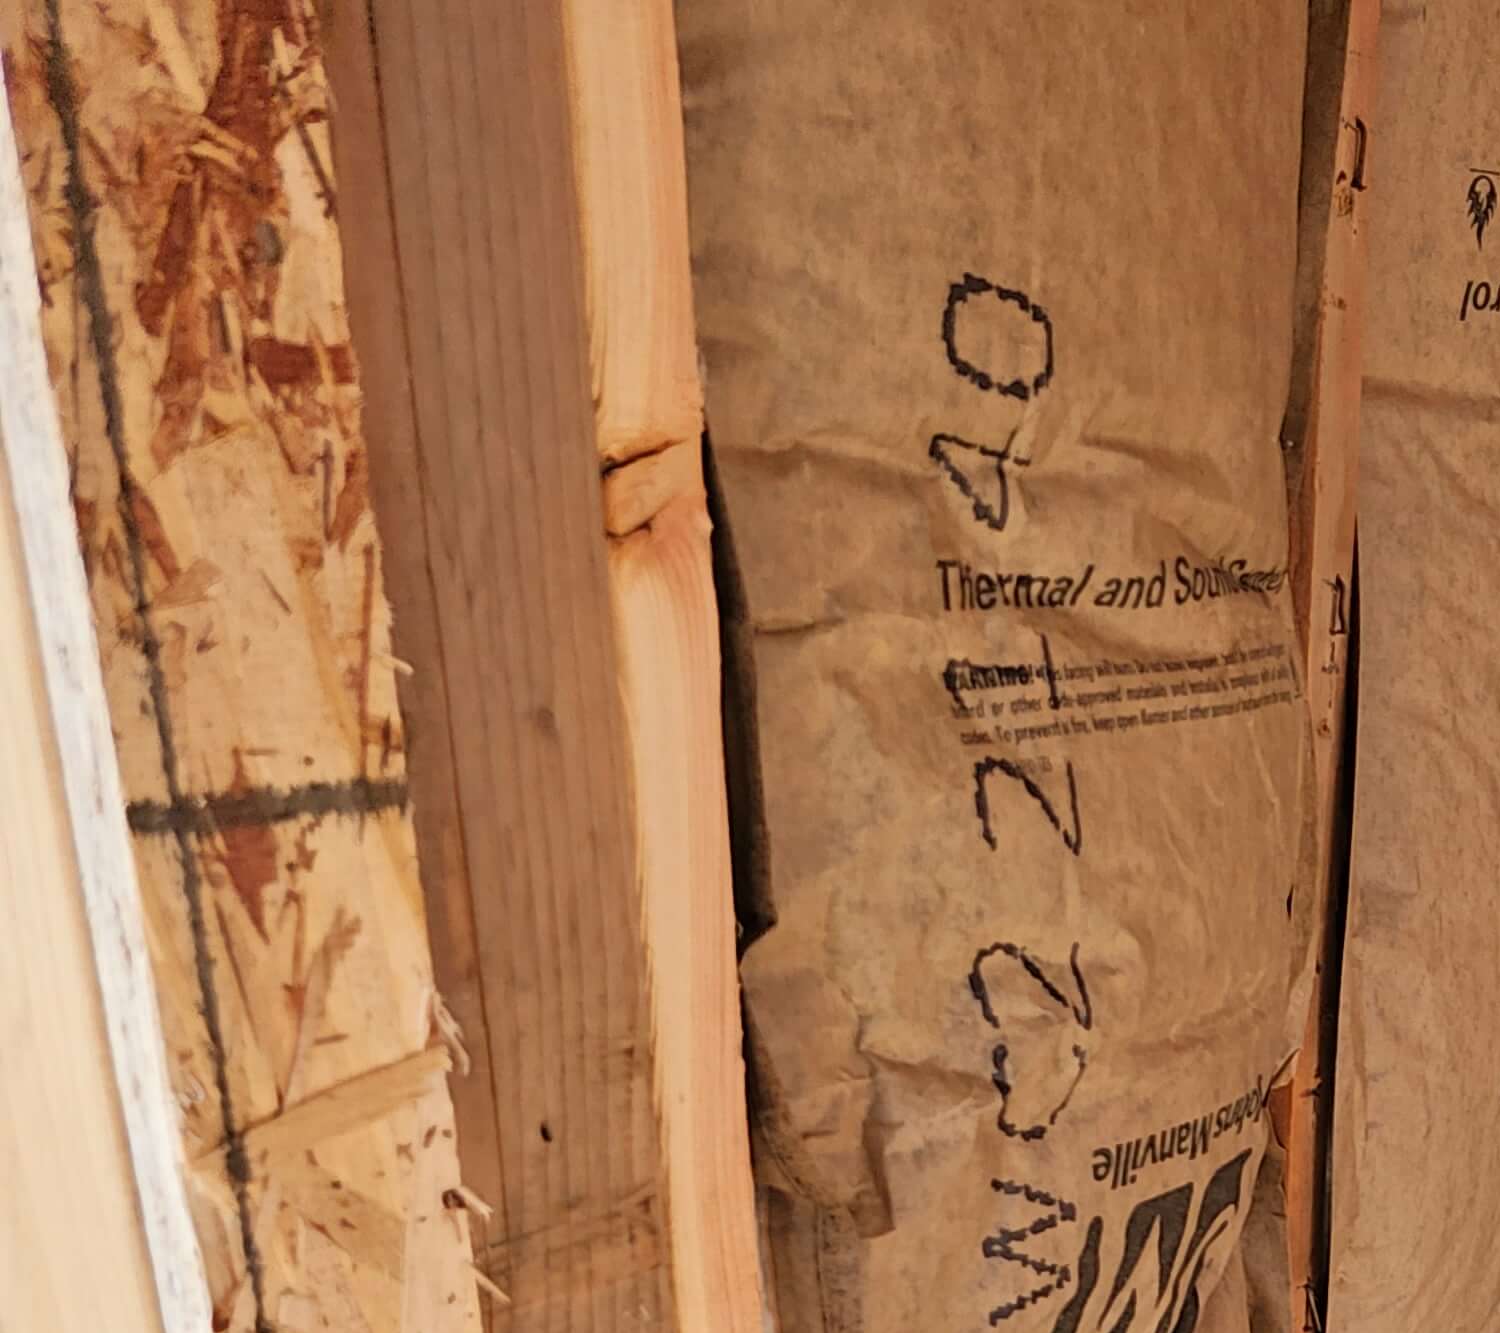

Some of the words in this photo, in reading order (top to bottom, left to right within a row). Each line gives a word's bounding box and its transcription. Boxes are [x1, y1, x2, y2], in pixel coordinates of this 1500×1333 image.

[936, 559, 1096, 612] Thermal
[1093, 562, 1166, 609] and
[1091, 1107, 1214, 1192] Manville
